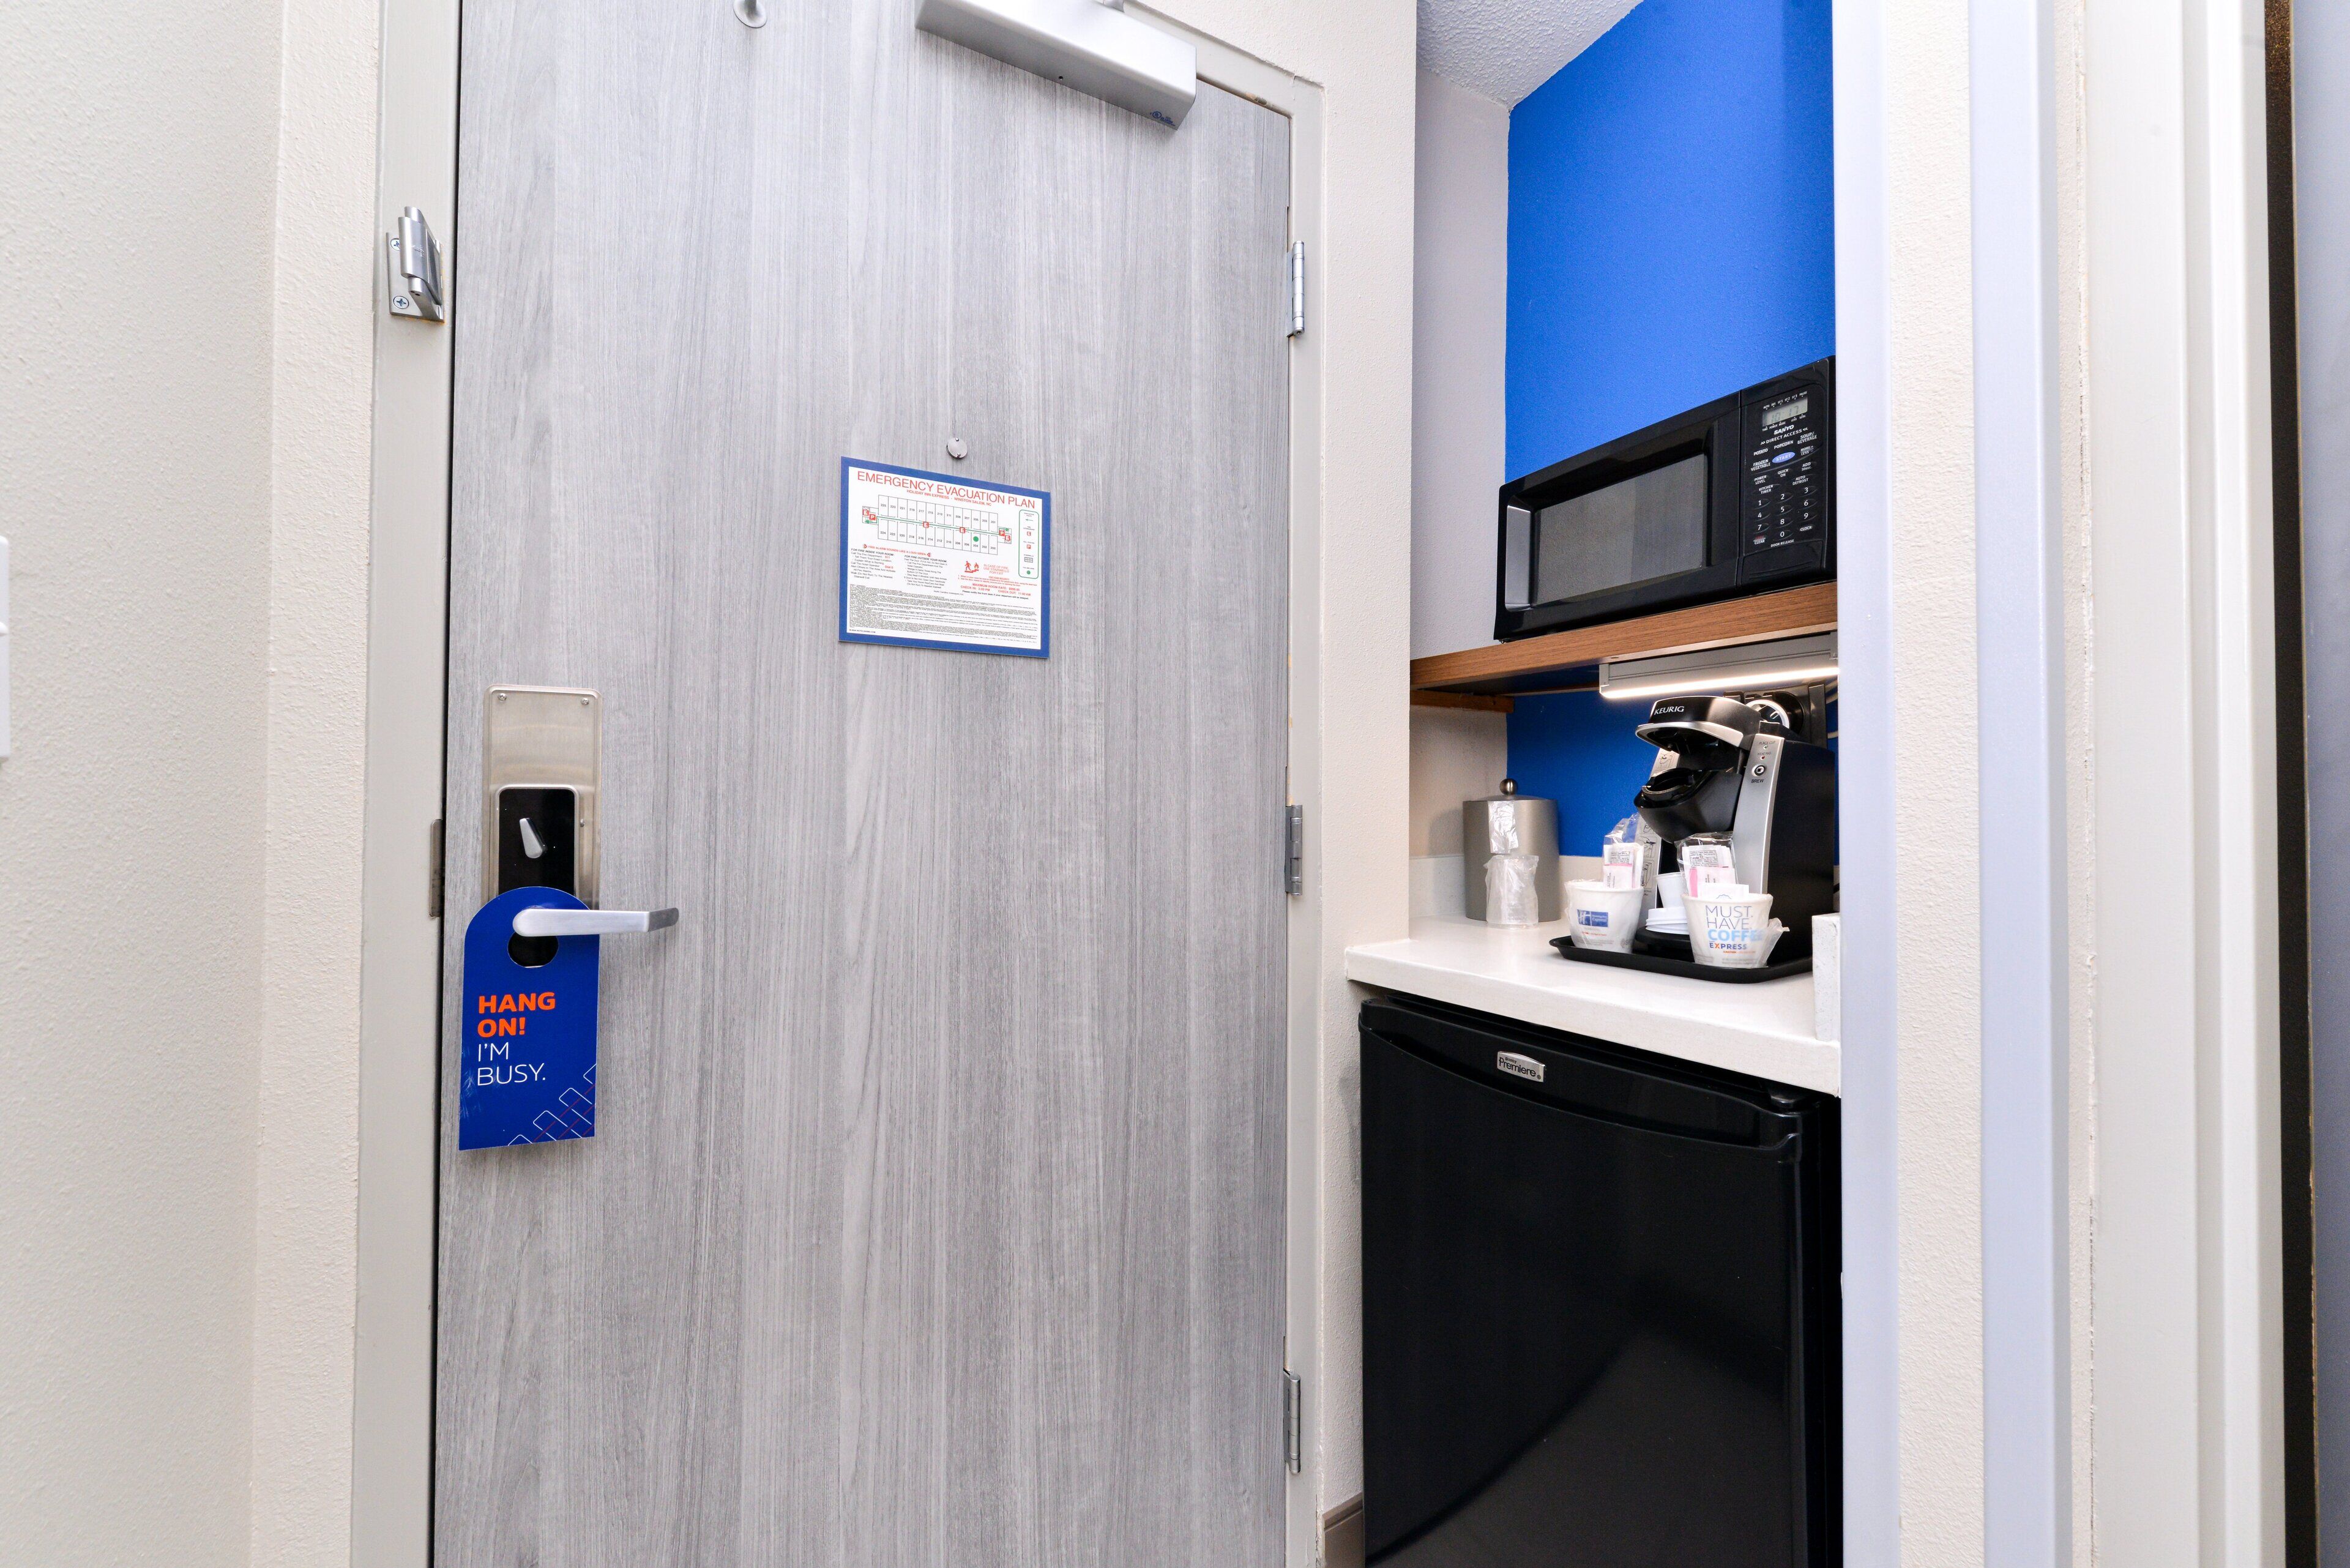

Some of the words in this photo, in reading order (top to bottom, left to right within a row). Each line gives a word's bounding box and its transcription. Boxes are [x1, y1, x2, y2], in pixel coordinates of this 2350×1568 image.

[1766, 435, 1783, 444] DIRECT
[1783, 429, 1802, 438] ACCESS
[1774, 425, 1794, 435] SANYO
[1774, 440, 1794, 449] POPCORN
[1797, 435, 1817, 444] BEVERAGE
[1750, 462, 1771, 471] VEGETABLE
[857, 471, 934, 492] EMERGENCY
[937, 484, 1005, 504] EVACUATION
[1008, 496, 1035, 509] PLAN
[1654, 706, 1684, 715] KEURIG
[1705, 905, 1753, 918] MUST.
[479, 991, 556, 1014] HANG
[477, 1017, 526, 1038] ON!
[1498, 1056, 1537, 1077] Premiere
[477, 1062, 546, 1086] BUSY.
